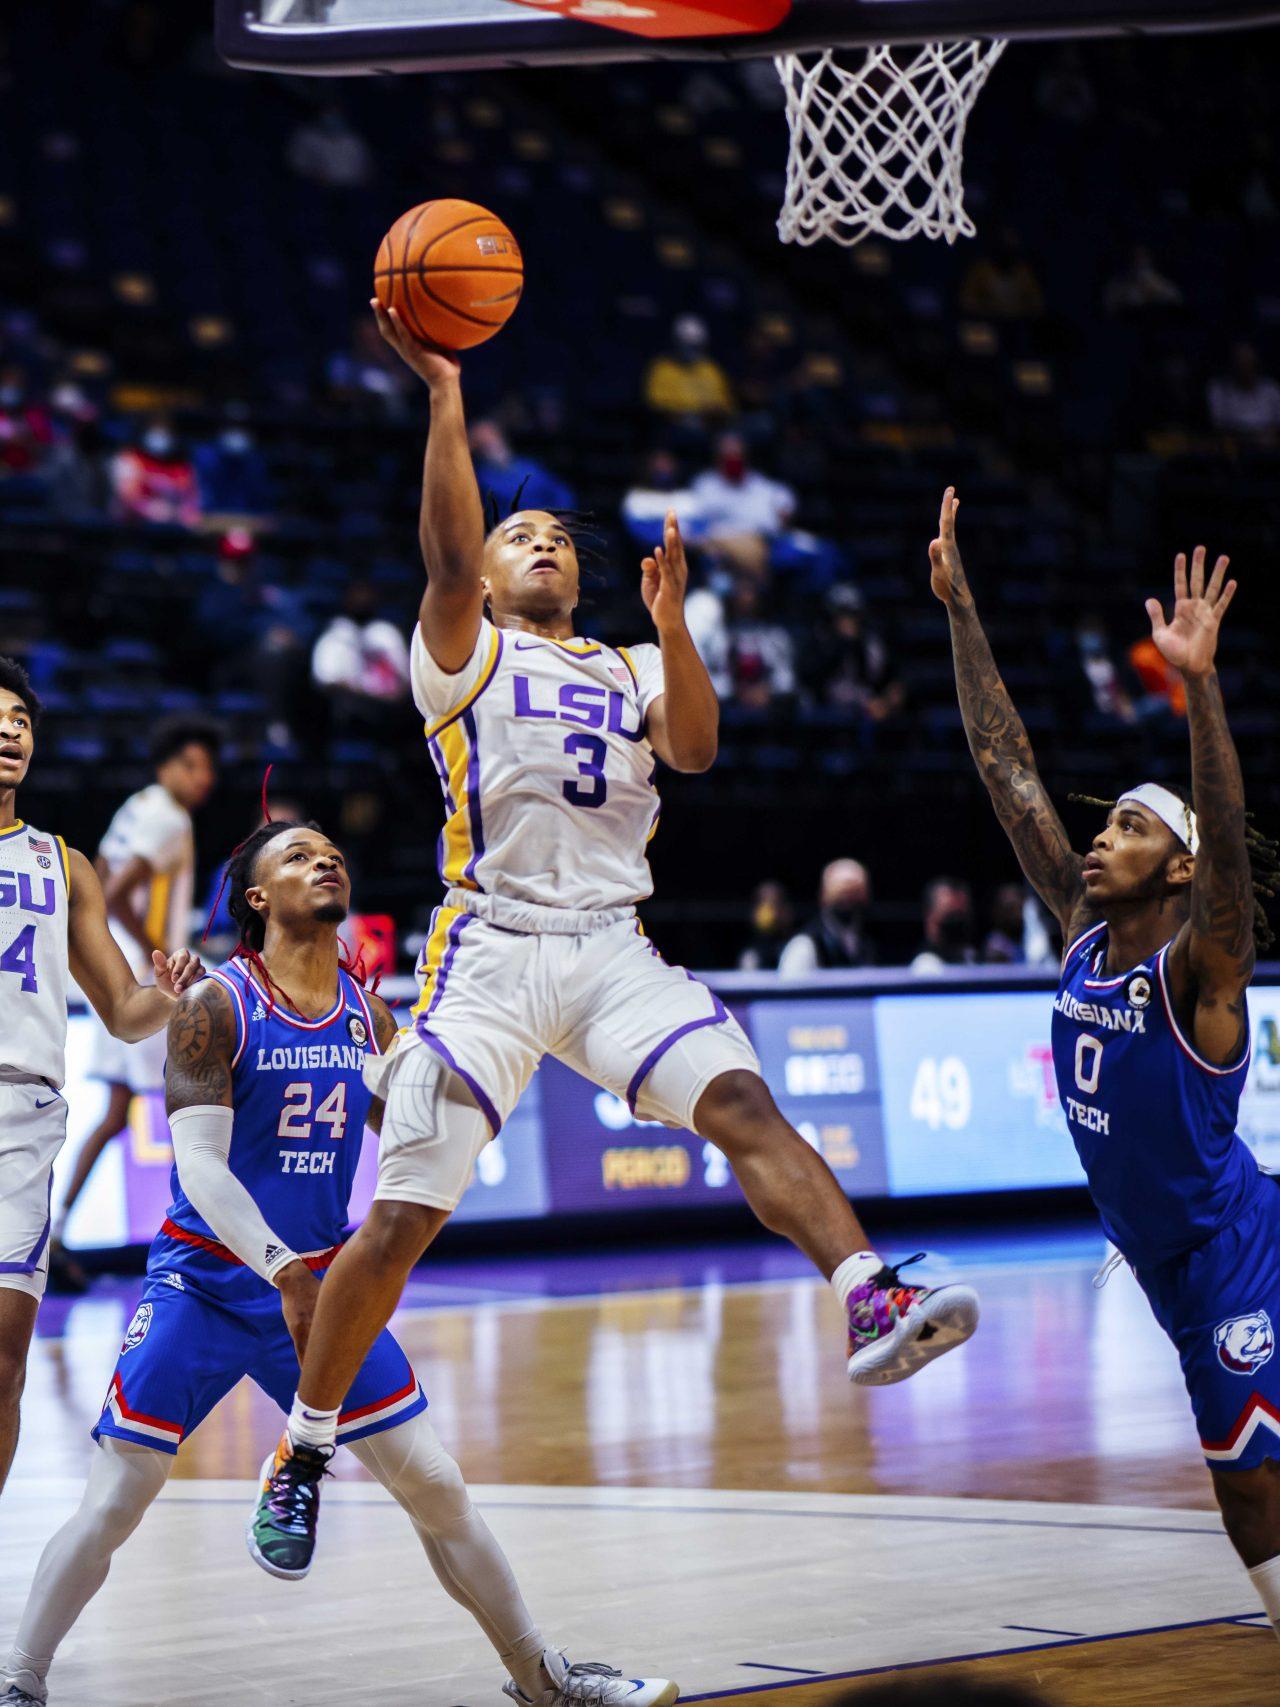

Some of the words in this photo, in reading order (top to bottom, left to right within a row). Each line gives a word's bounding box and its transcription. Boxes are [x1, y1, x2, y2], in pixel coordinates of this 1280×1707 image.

[562, 732, 608, 809] 3
[1075, 1033, 1104, 1095] 0
[276, 1081, 348, 1140] 24
[1066, 1096, 1110, 1136] TECH
[278, 1150, 336, 1174] TECH
